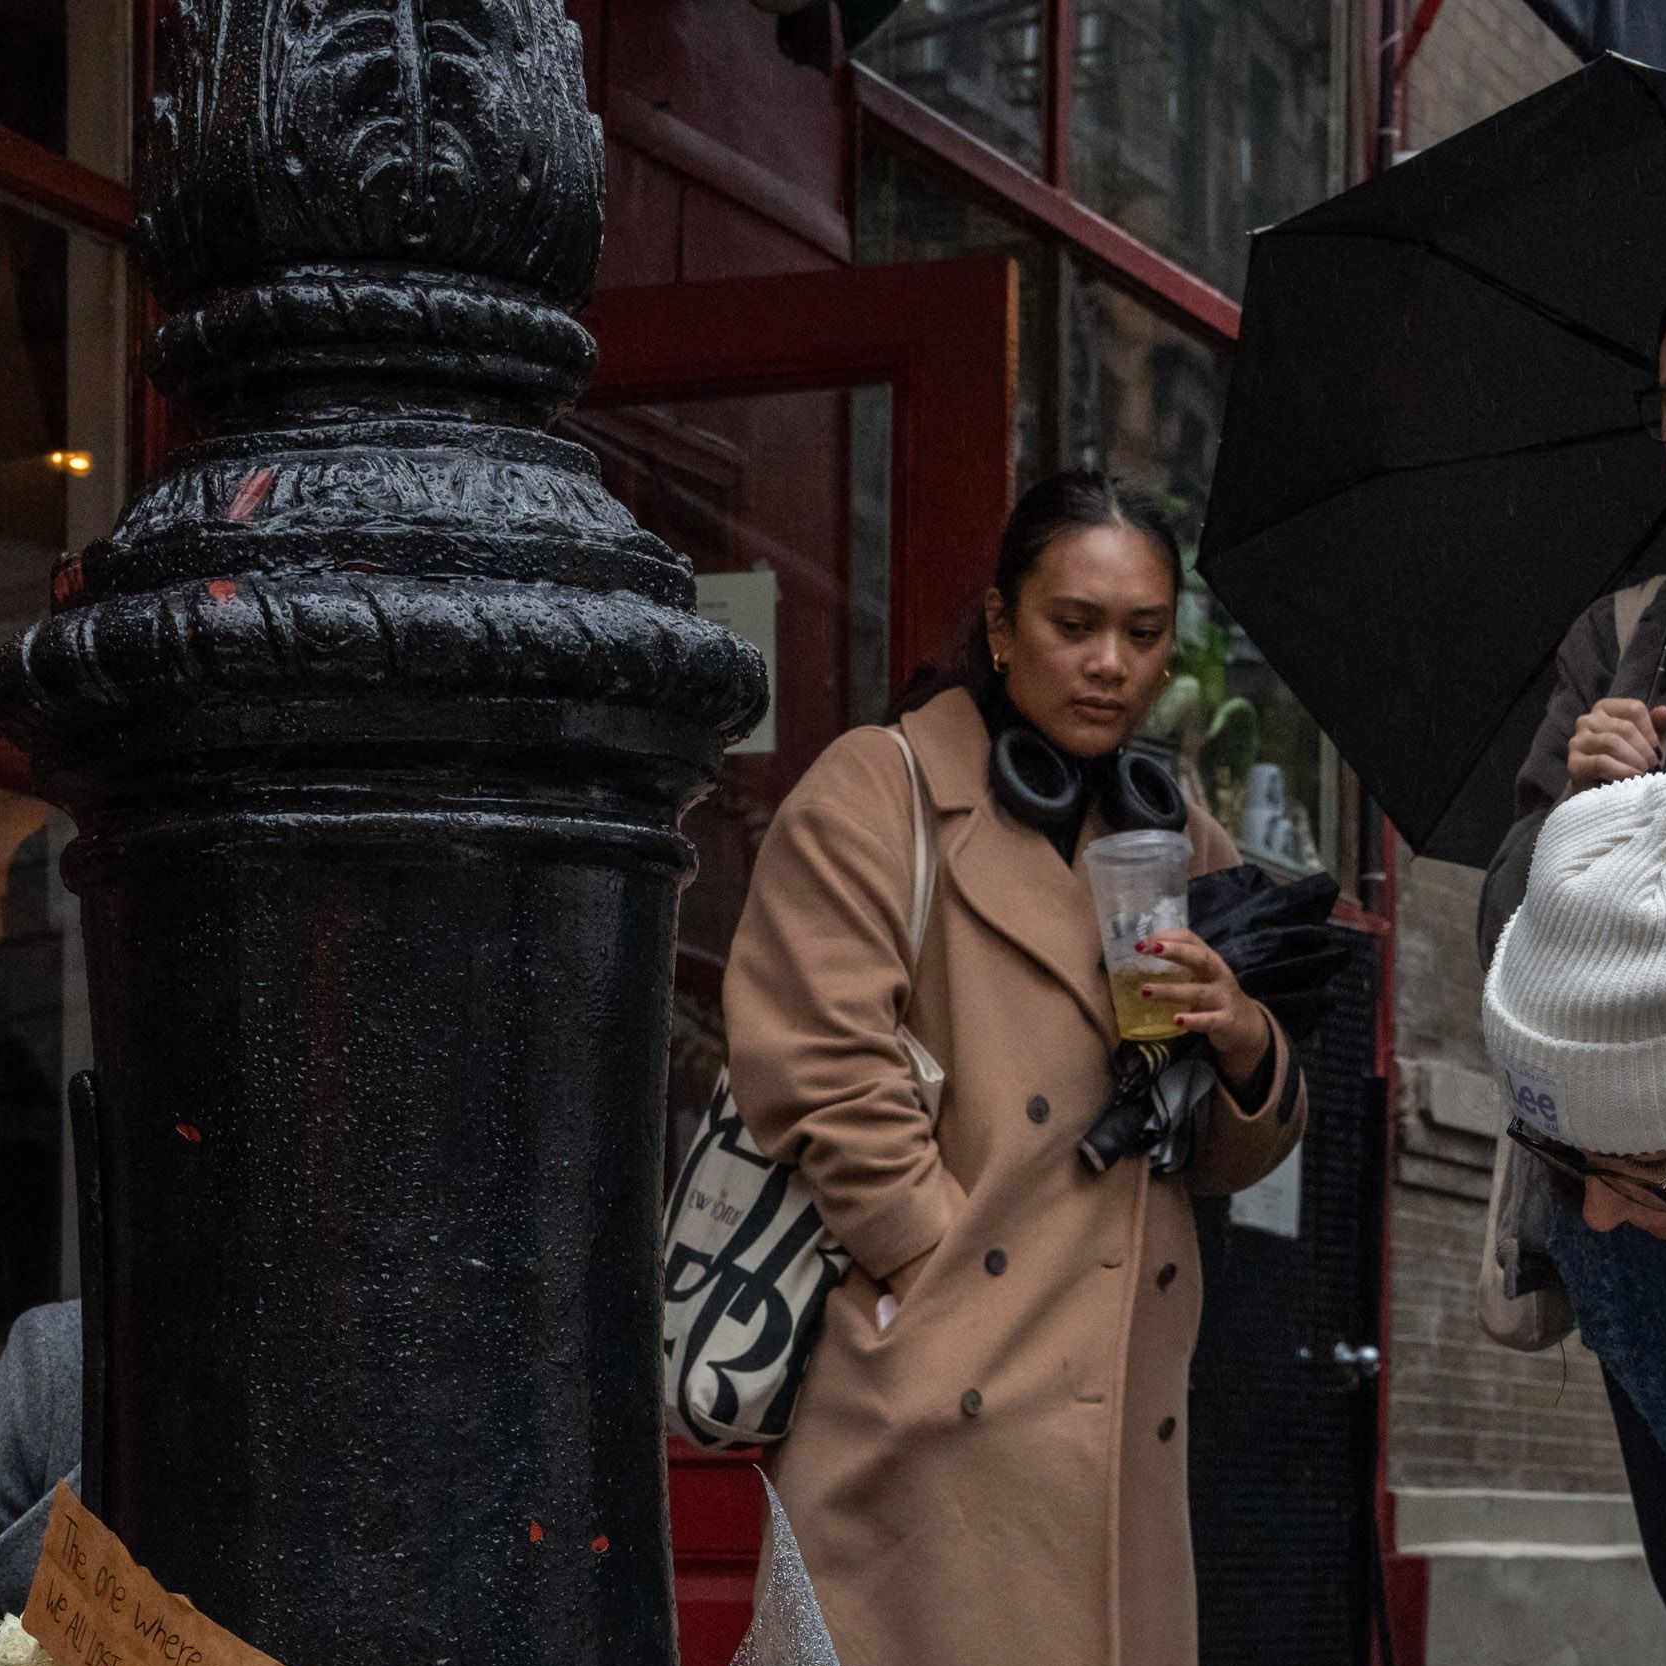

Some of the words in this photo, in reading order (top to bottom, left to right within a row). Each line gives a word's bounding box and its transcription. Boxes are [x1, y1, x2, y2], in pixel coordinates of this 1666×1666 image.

[1504, 1069, 1558, 1122] Lee
[61, 1514, 87, 1582] The
[95, 1565, 126, 1614] one
